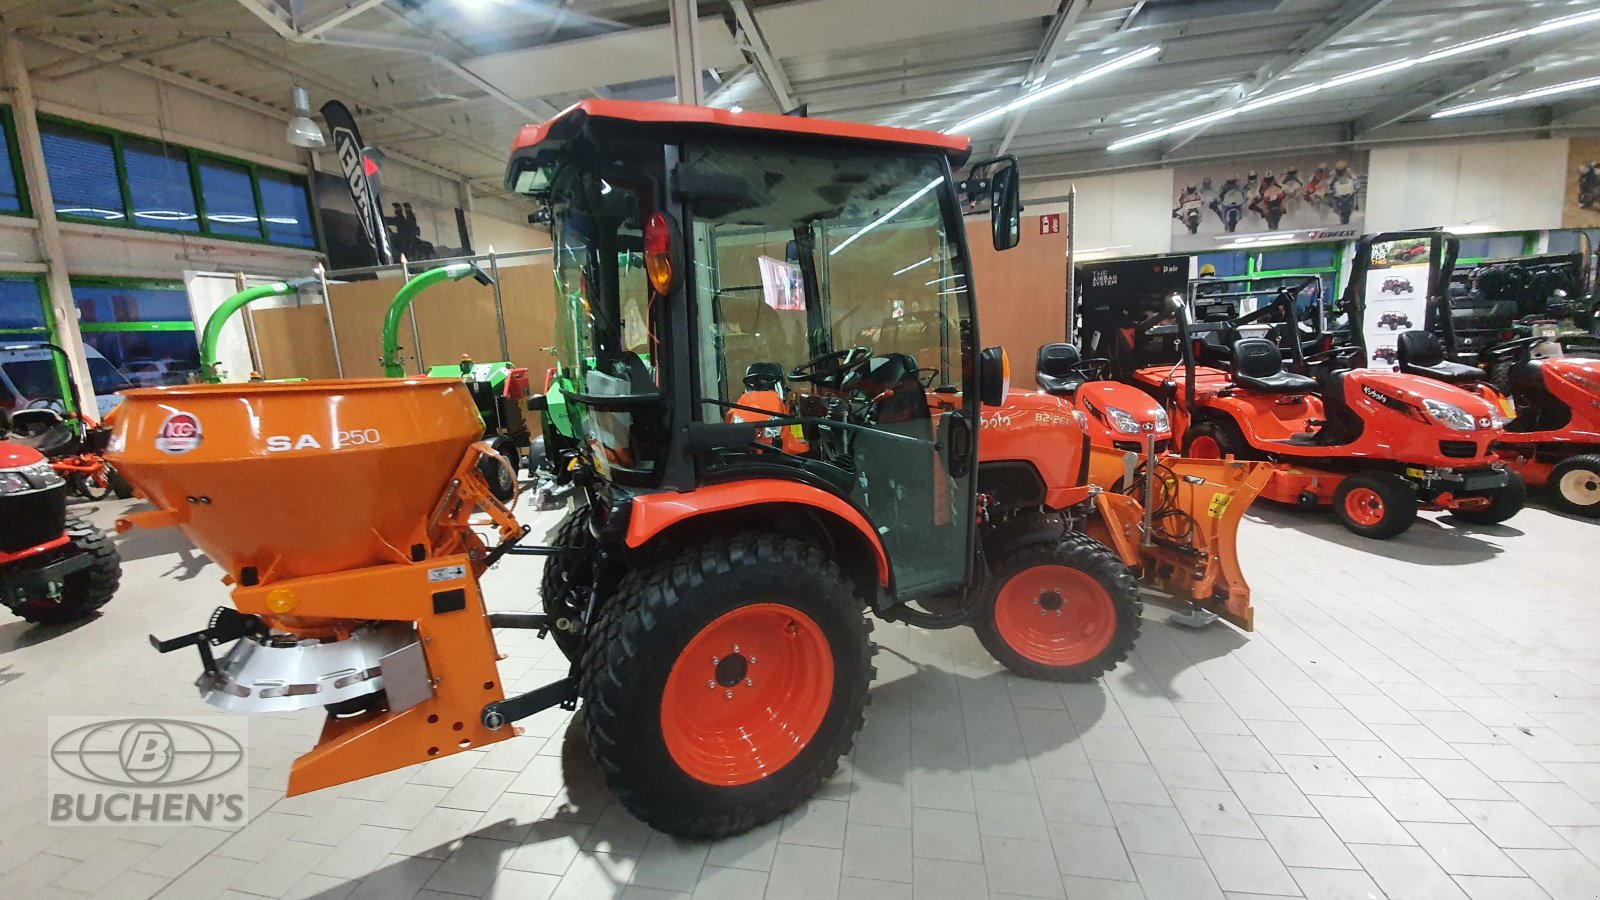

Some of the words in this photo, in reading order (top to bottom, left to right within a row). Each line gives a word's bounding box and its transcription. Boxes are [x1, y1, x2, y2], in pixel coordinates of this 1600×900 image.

[1363, 385, 1387, 403] Kubota
[980, 412, 1011, 429] bota
[266, 433, 321, 452] SA
[338, 428, 381, 446] 250
